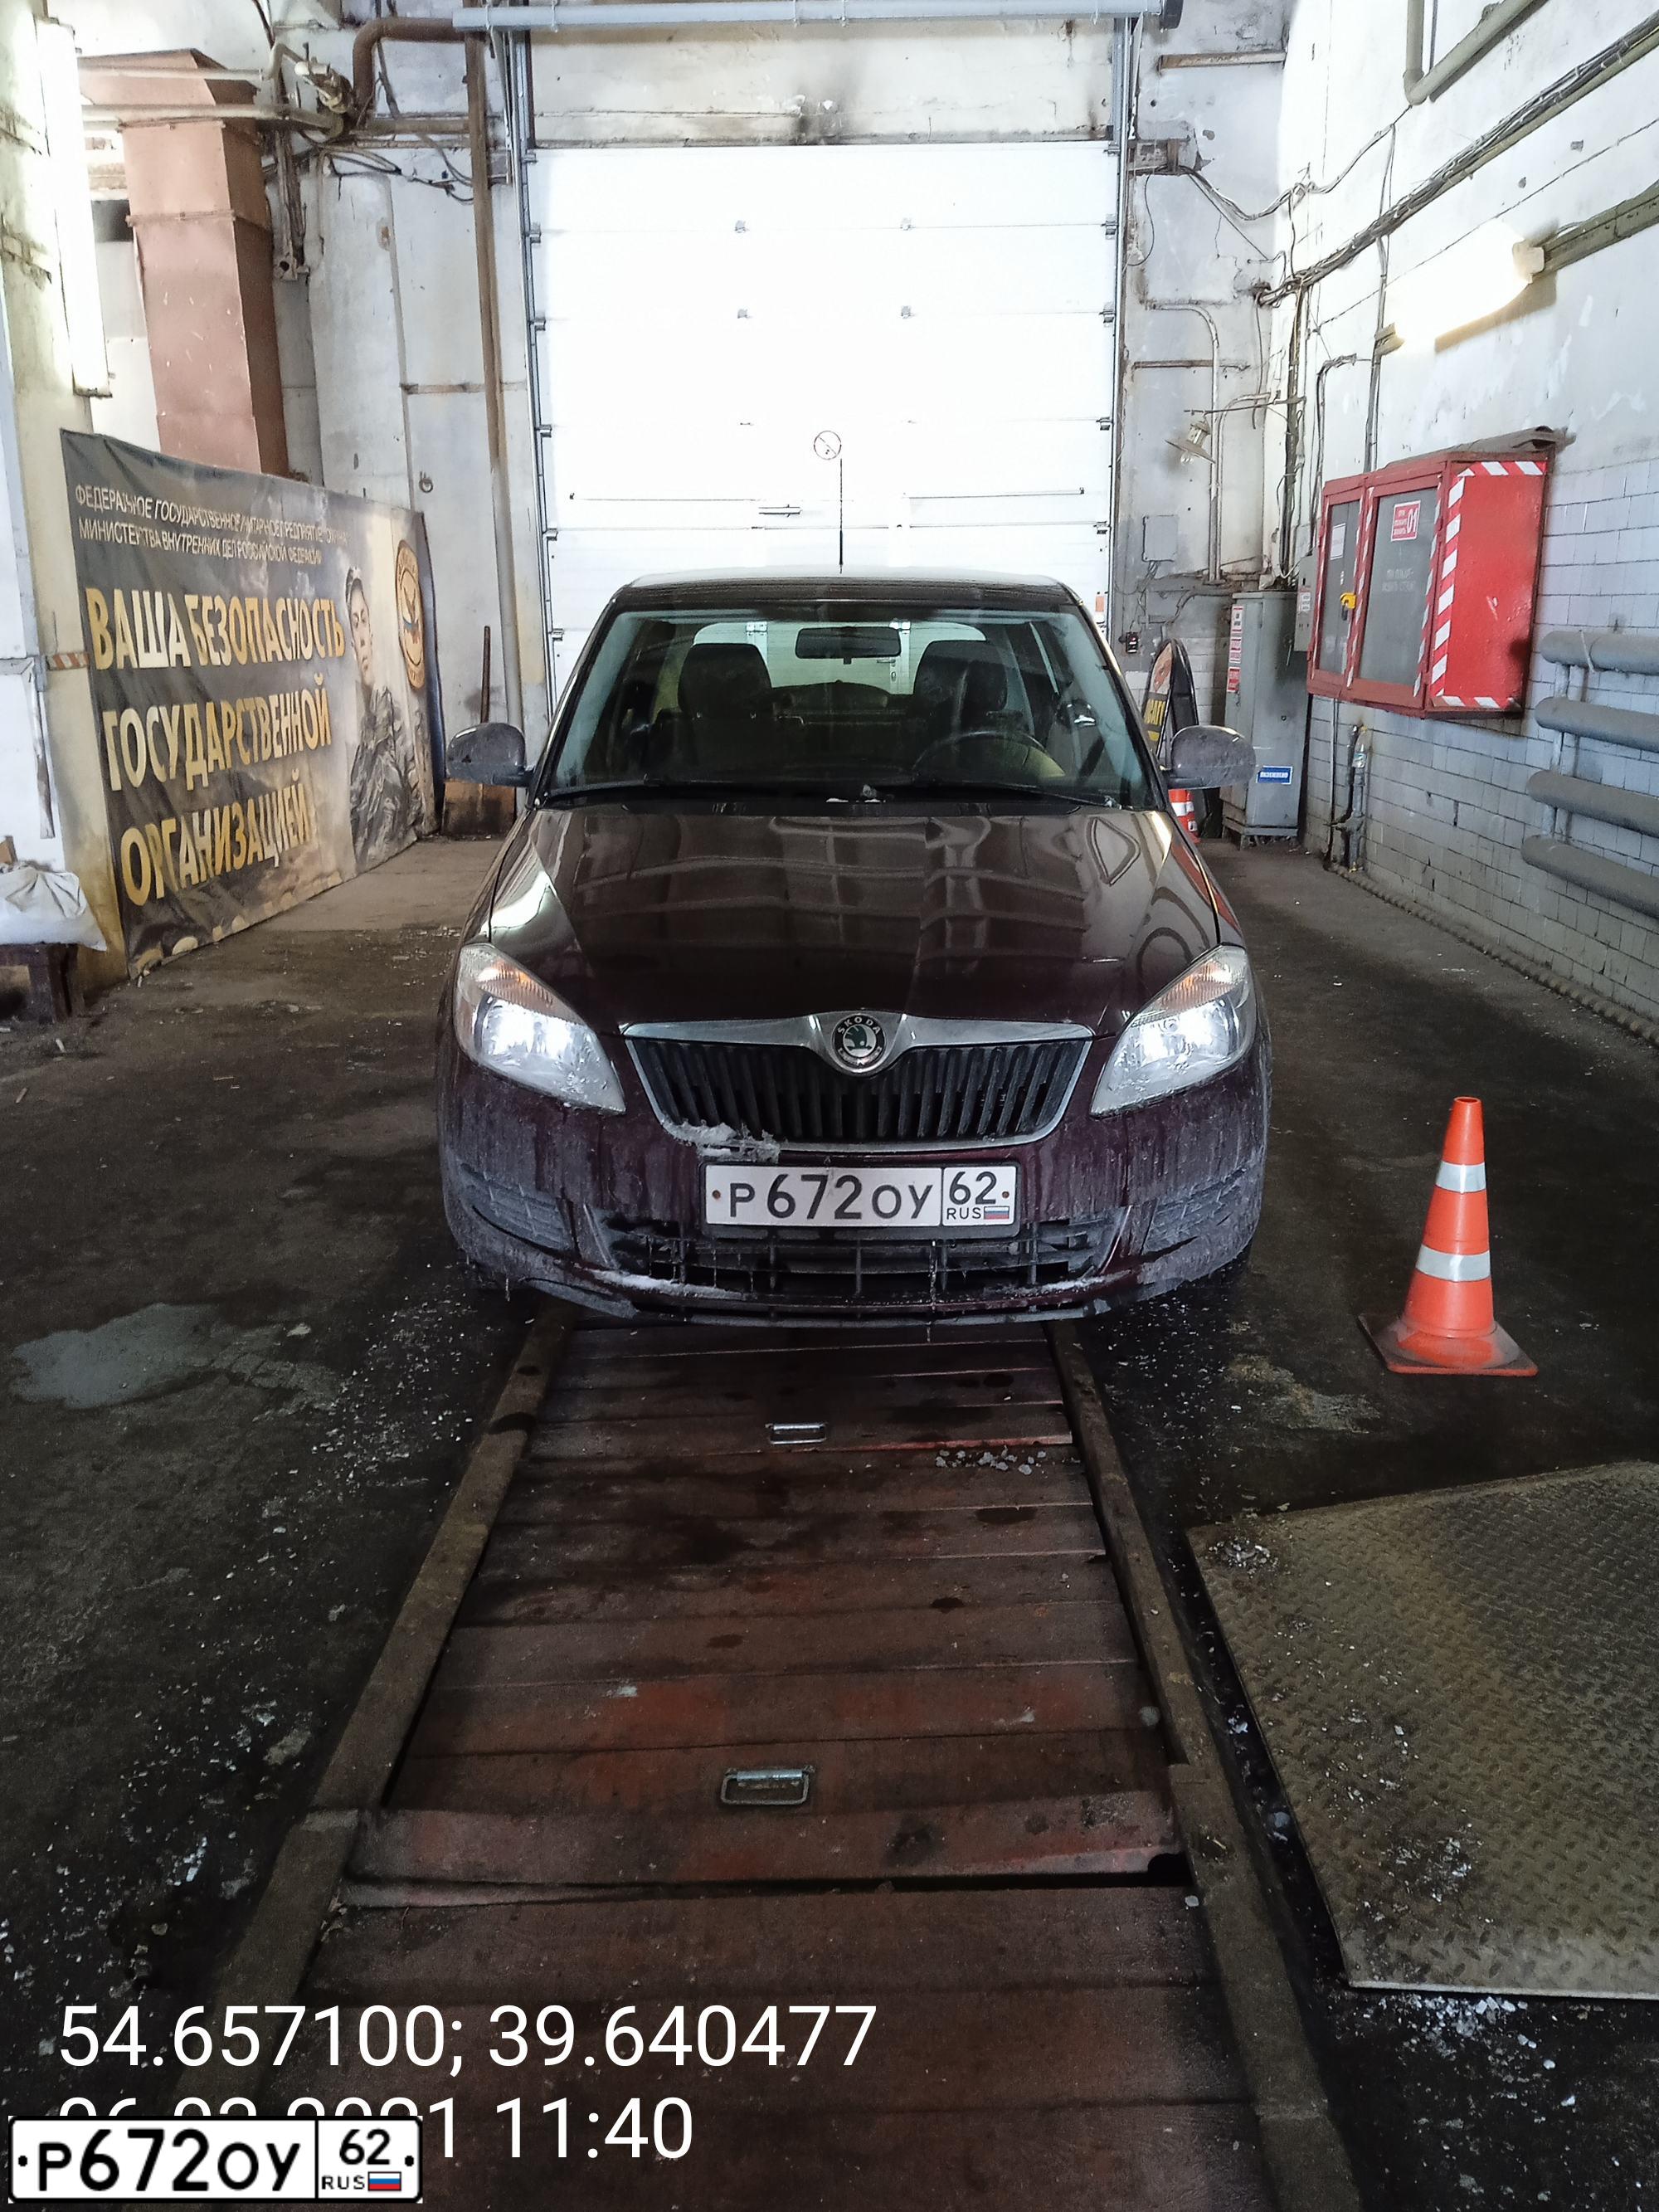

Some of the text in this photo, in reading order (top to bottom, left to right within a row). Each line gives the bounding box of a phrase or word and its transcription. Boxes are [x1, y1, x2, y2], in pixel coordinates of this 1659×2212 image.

[85, 587, 345, 670] ВАША БЕЗОПАСНОСТЬ
[102, 673, 332, 792] ГОСУДАРСТВЕННОЙ
[120, 768, 309, 907] ОРГАНИЗАЦИЕЙ
[946, 1207, 982, 1220] RUS
[949, 1171, 997, 1206] 62
